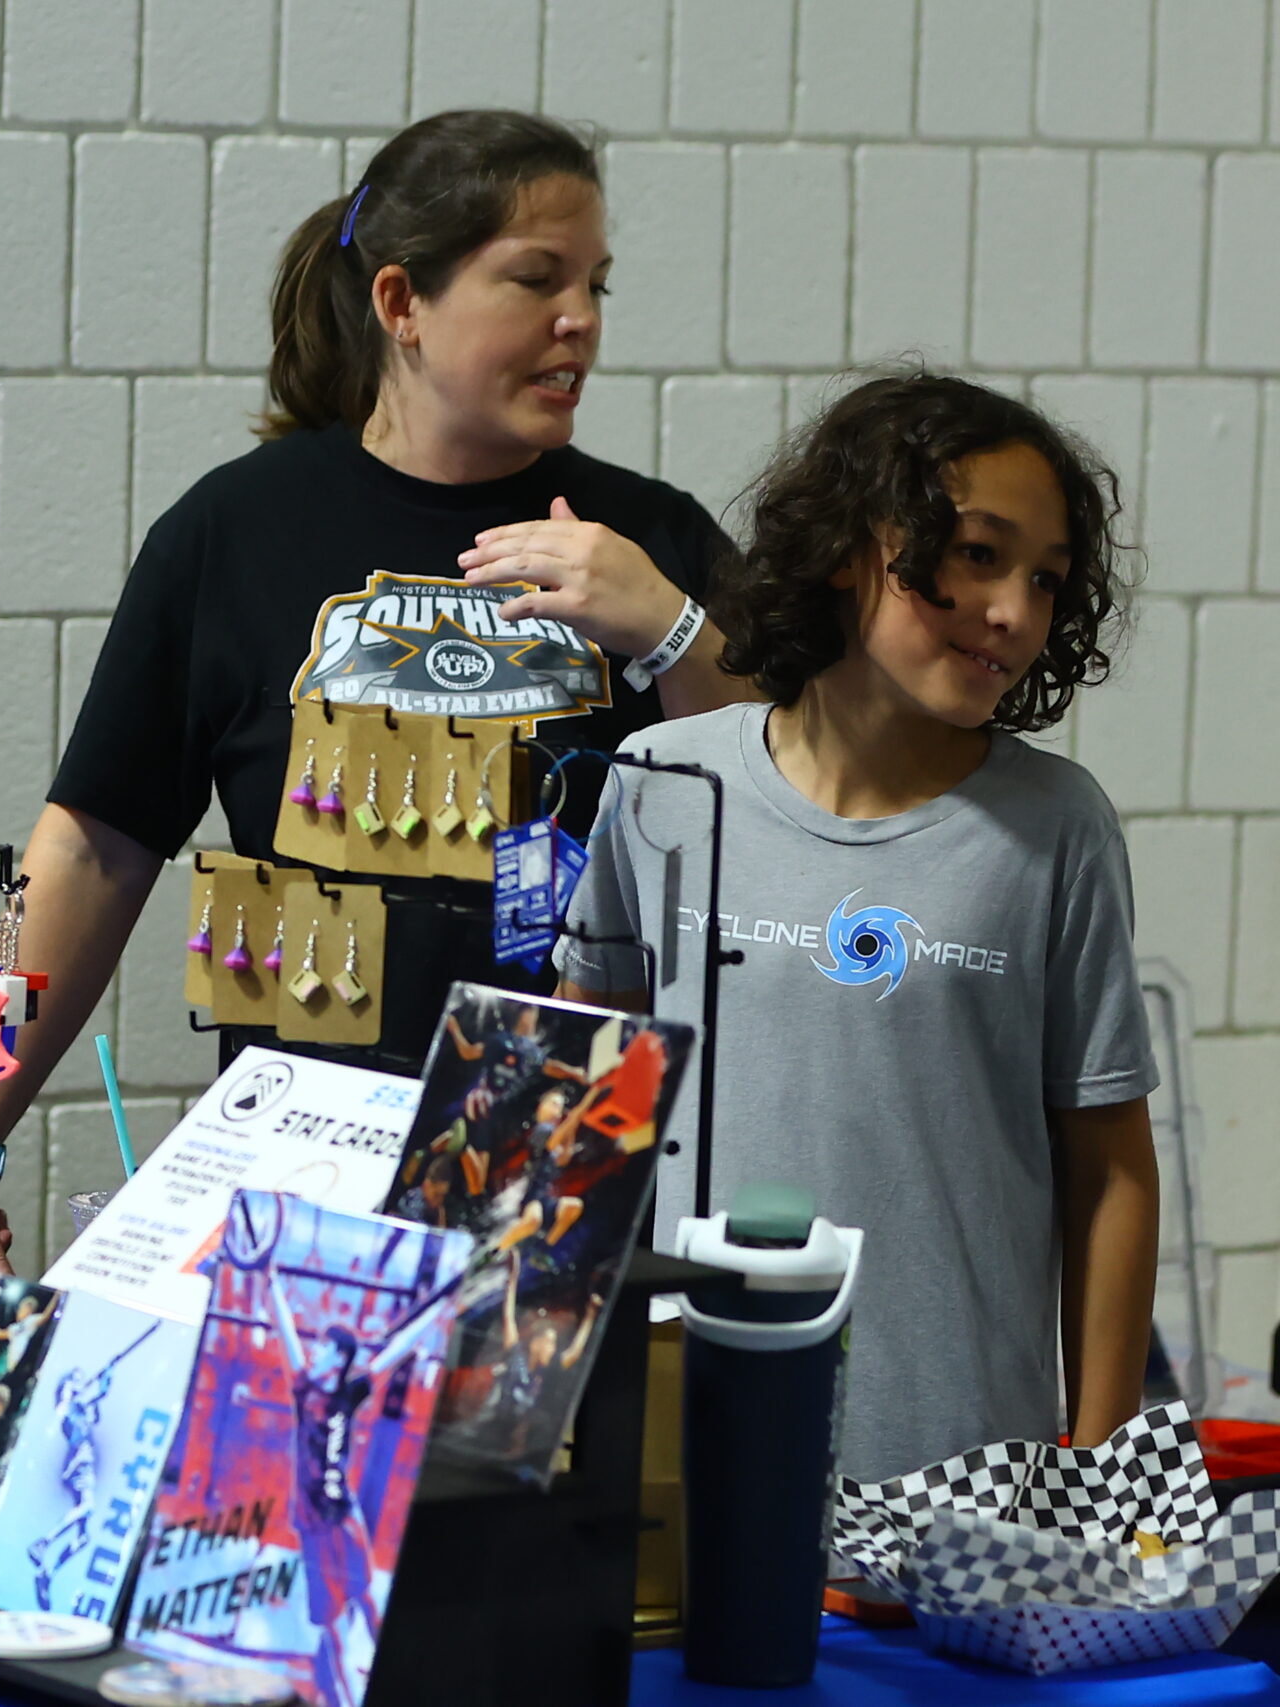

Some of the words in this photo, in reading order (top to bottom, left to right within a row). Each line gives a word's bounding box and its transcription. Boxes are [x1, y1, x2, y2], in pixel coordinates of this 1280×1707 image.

[391, 585, 436, 595] HOSTED
[439, 586, 456, 595] BY
[459, 589, 497, 600] LEVEL
[664, 613, 696, 653] ATHLETE
[329, 679, 361, 700] 20
[373, 689, 482, 714] ALL-STAR
[485, 686, 555, 712] EVENT
[677, 906, 822, 949] CYCLONE
[913, 937, 1009, 975] MADE
[273, 1110, 336, 1142] STAT
[73, 1407, 172, 1621] CYRUS
[152, 1497, 276, 1567] ETHAN
[136, 1553, 300, 1636] MATTERN
